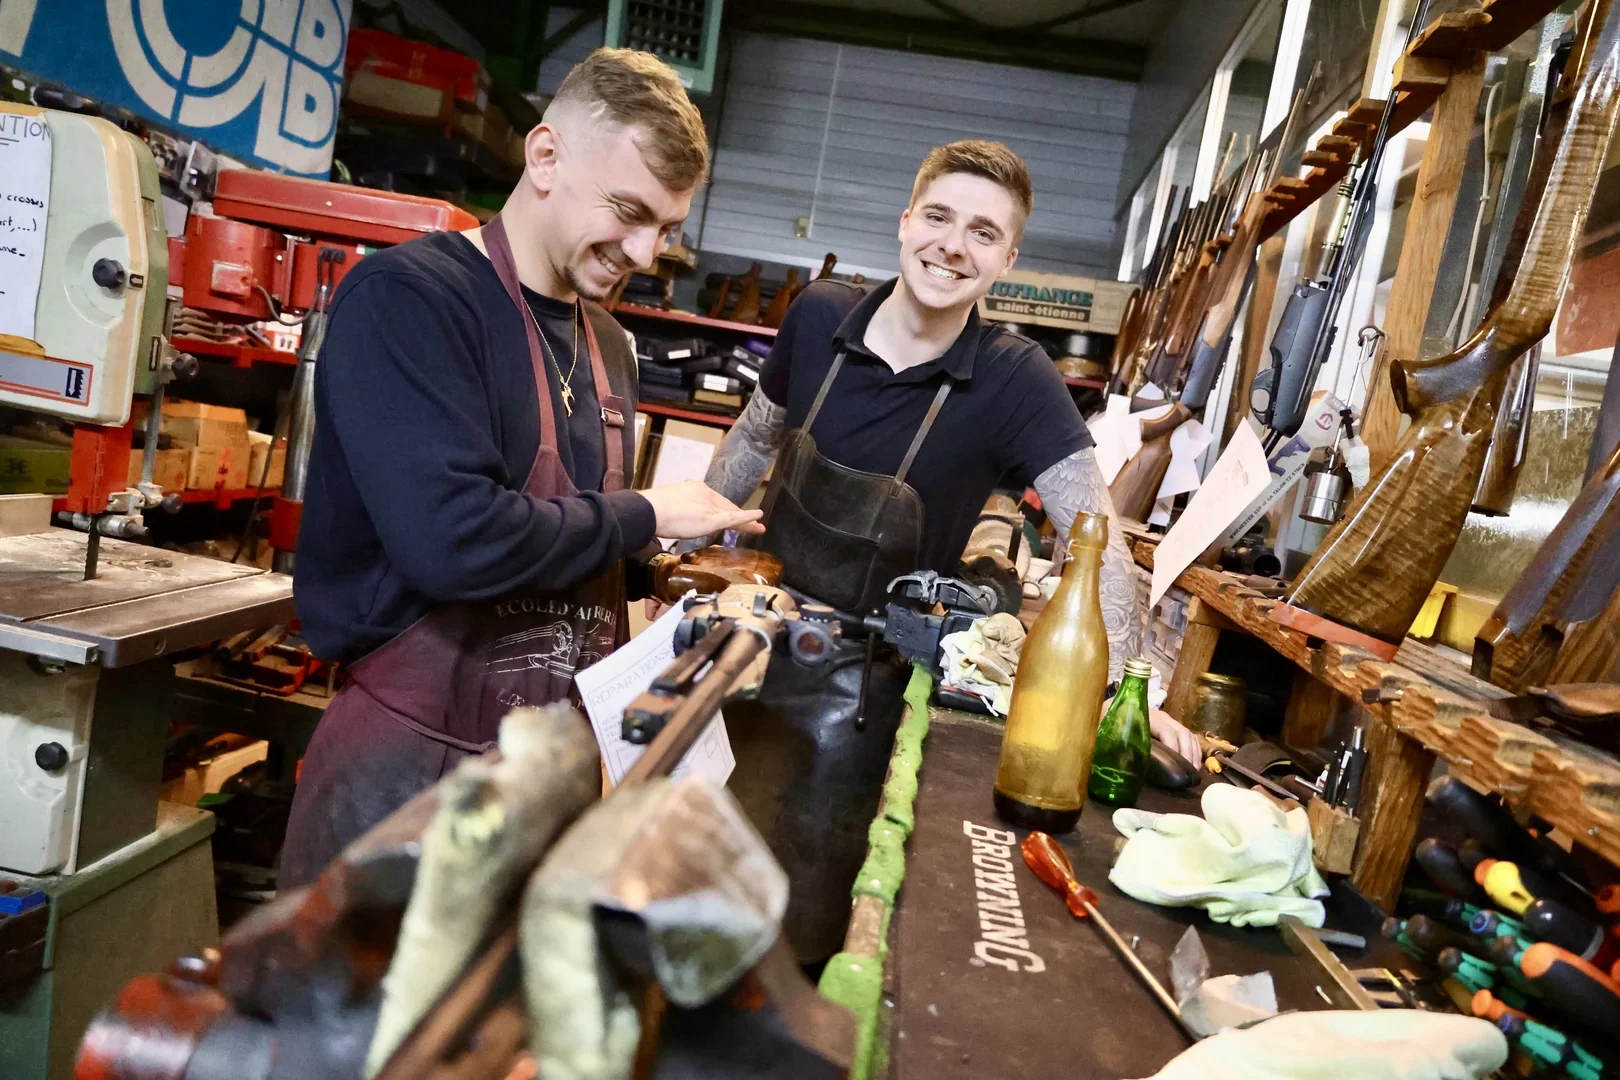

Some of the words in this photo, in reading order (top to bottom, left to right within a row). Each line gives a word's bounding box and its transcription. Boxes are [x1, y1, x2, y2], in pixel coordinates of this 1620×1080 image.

[995, 302, 1085, 320] saint-étienne
[1229, 514, 1254, 539] WINCHESTER
[1273, 481, 1287, 495] TALON
[1292, 462, 1306, 476] STOCK
[963, 820, 1046, 973] BROWNING
